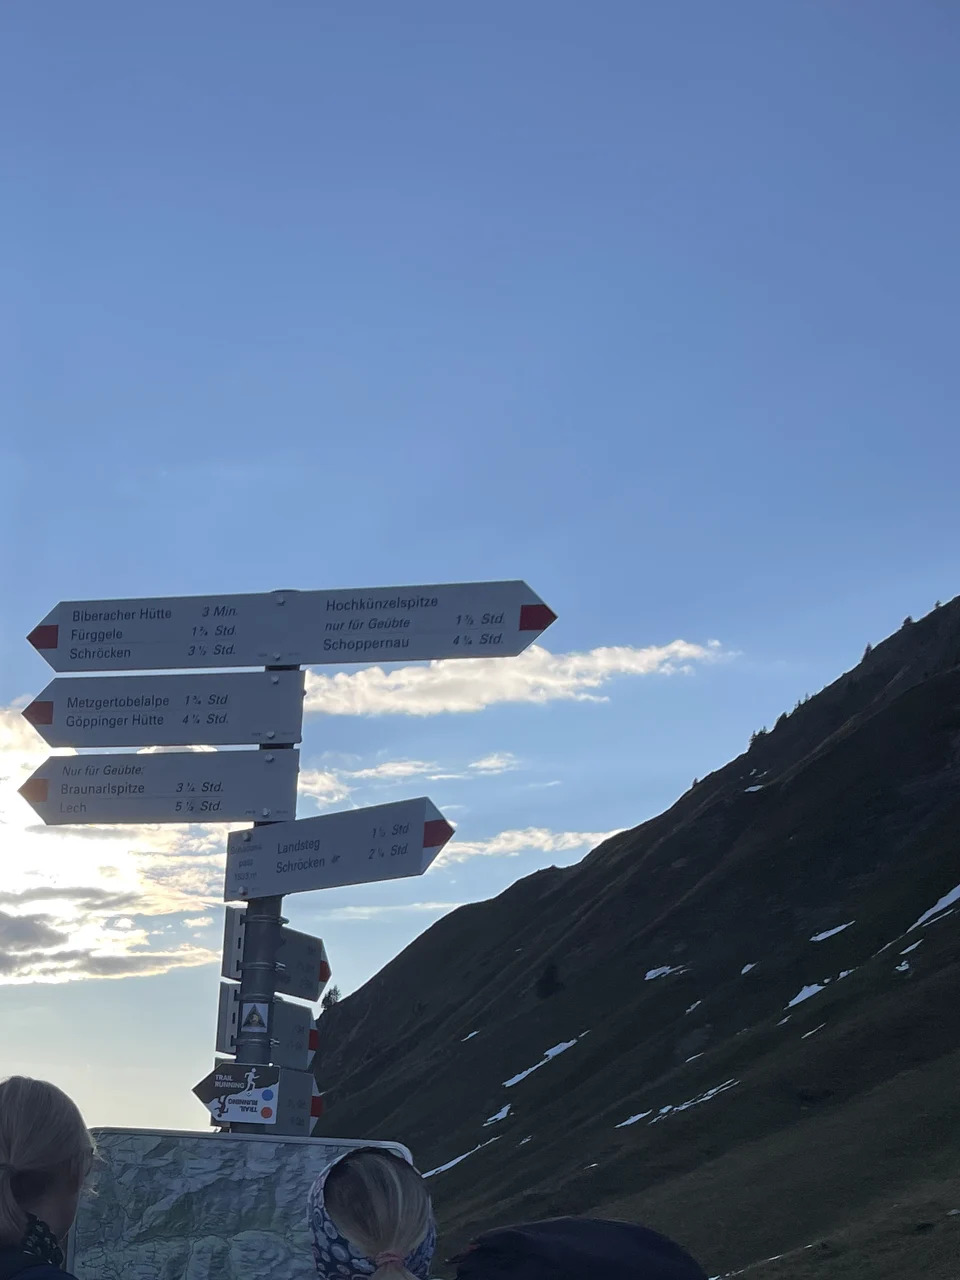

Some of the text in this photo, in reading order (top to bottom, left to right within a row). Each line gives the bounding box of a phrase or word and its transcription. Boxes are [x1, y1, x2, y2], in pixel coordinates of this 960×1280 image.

[326, 595, 439, 612] Hochkünzelspitze
[72, 609, 136, 622] Biberacher
[139, 608, 172, 620] Hütte
[202, 606, 210, 618] 3
[324, 621, 345, 631] nur
[347, 619, 364, 631] für
[368, 617, 411, 630] Geübte
[71, 628, 123, 643] Fürggele
[69, 647, 131, 660] Schröcken
[213, 644, 236, 656] Std.
[323, 638, 410, 653] Schoppernau
[67, 694, 170, 710] Metzgertobelalpe
[66, 715, 128, 729] Göppinger
[132, 714, 164, 726] Hütte
[62, 766, 82, 777] Nur
[84, 765, 100, 777] für
[61, 782, 145, 797] Braunarlspitze
[201, 781, 224, 793] Std.
[60, 802, 87, 814] Lech
[277, 839, 320, 855] Landsteg
[276, 857, 325, 874] Schröcken
